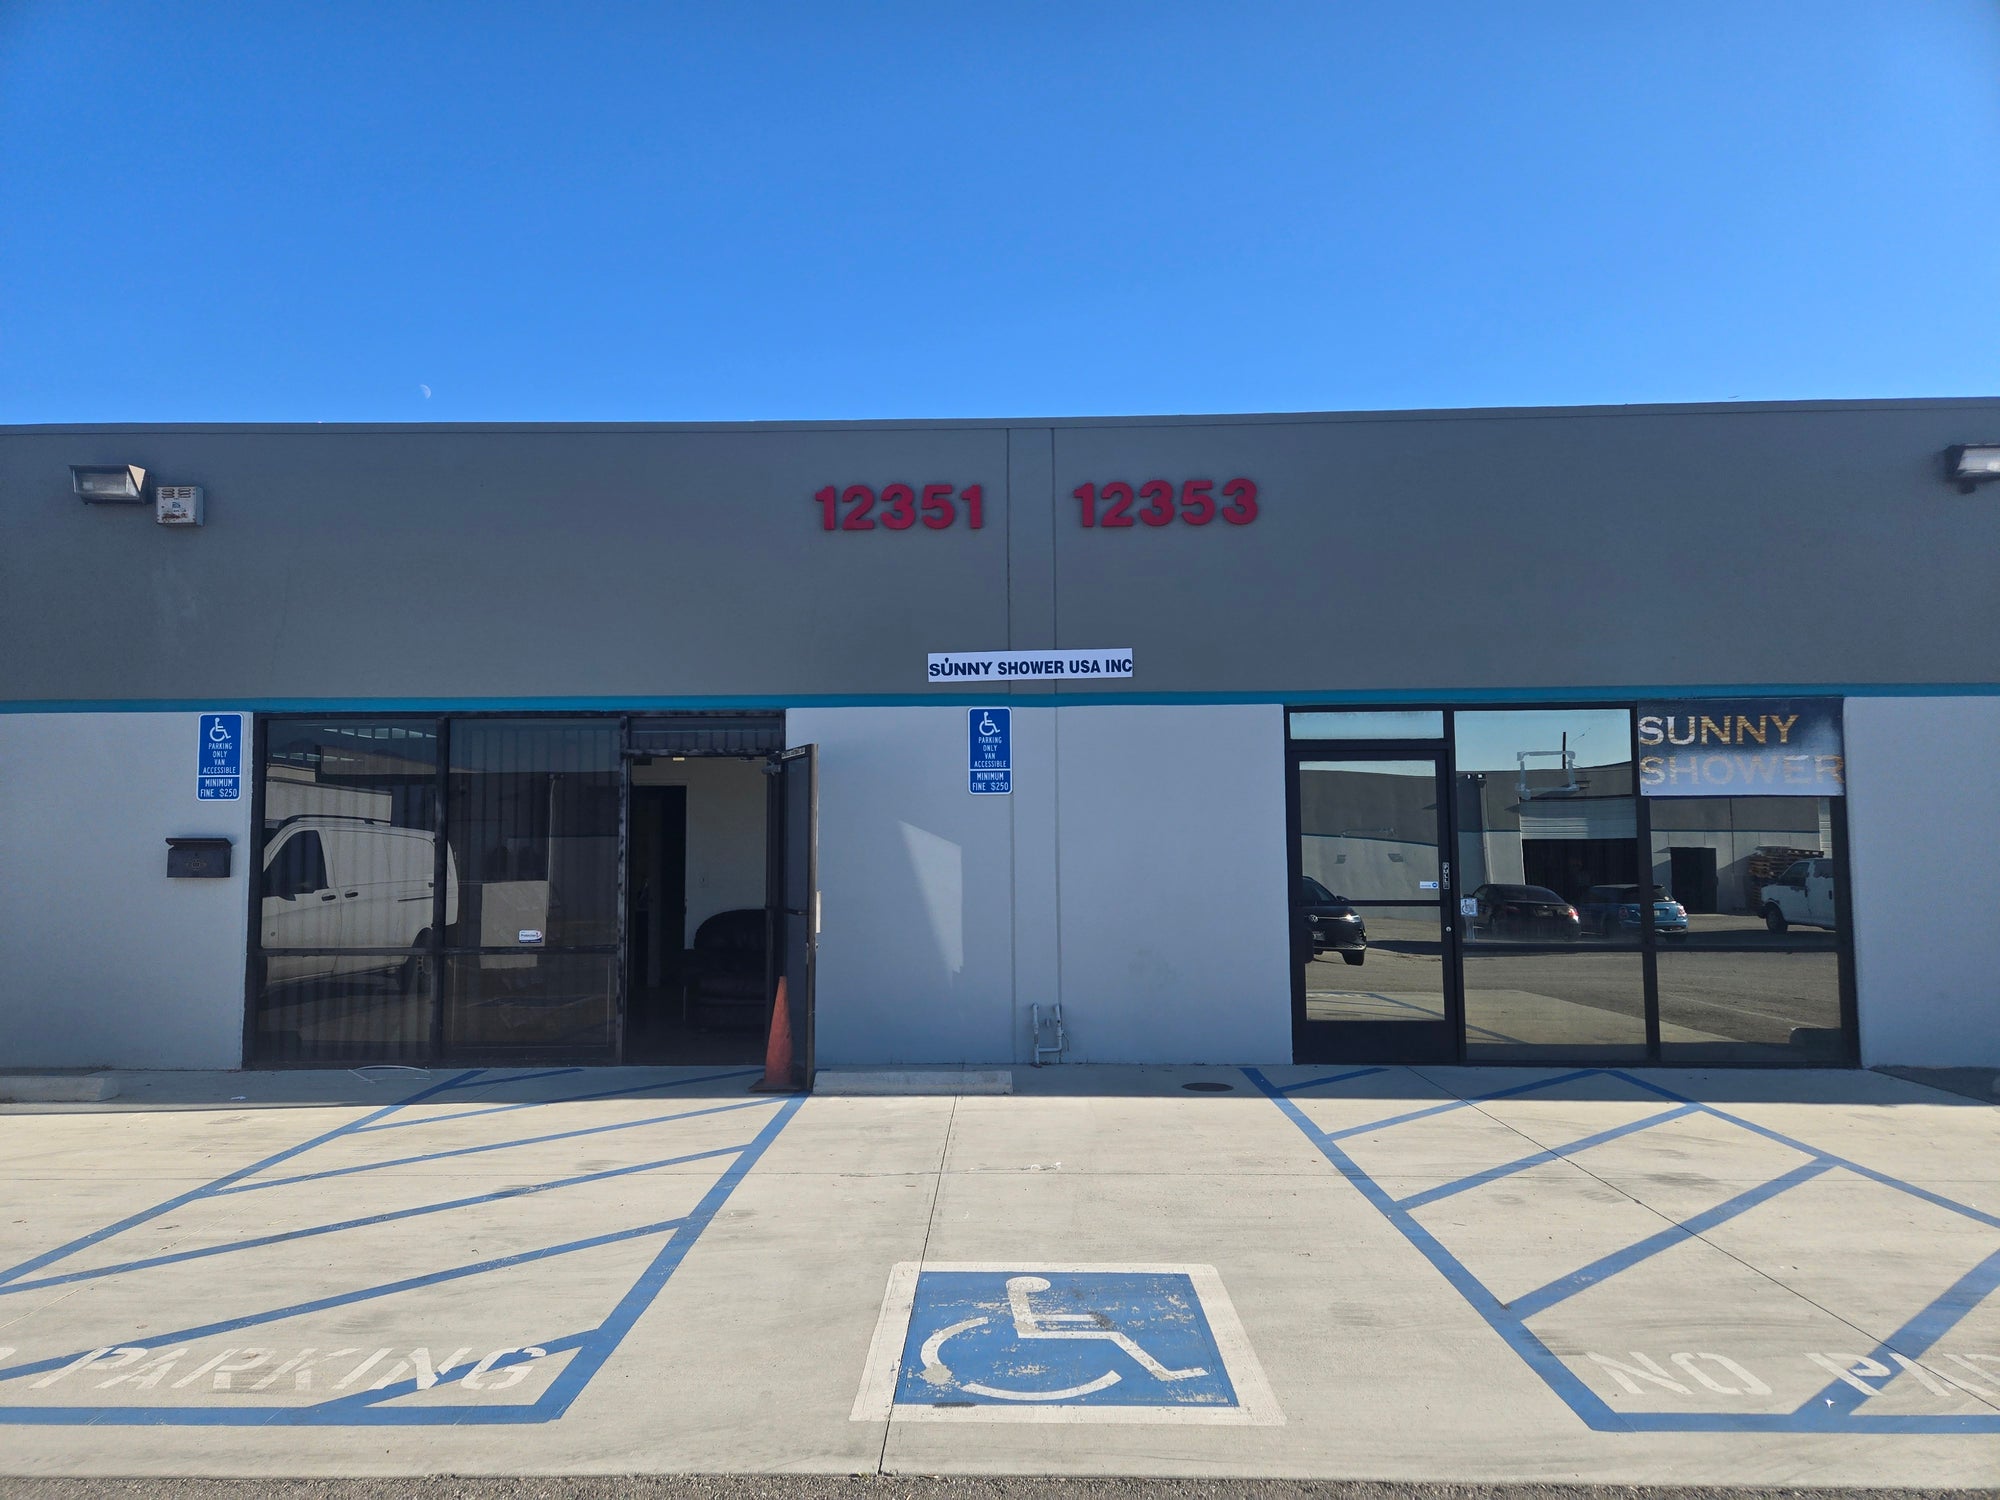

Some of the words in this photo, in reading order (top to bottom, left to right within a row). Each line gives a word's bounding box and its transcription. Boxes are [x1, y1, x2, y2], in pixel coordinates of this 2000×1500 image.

[815, 484, 982, 530] 12351
[1073, 478, 1259, 528] 12353
[998, 661, 1064, 675] SHOWER
[1069, 660, 1100, 674] USA
[1105, 659, 1133, 673] INC
[1638, 714, 1800, 746] SUNNY
[205, 778, 233, 787] MINIMUM
[976, 772, 1003, 780] MINIMUM
[1640, 754, 1845, 785] SHOWER
[200, 789, 214, 797] FINE
[219, 788, 237, 797] $250
[972, 783, 985, 791] FINE
[991, 783, 1009, 791] $250
[29, 1346, 547, 1391] PARKING
[1585, 1351, 1773, 1395] NO
